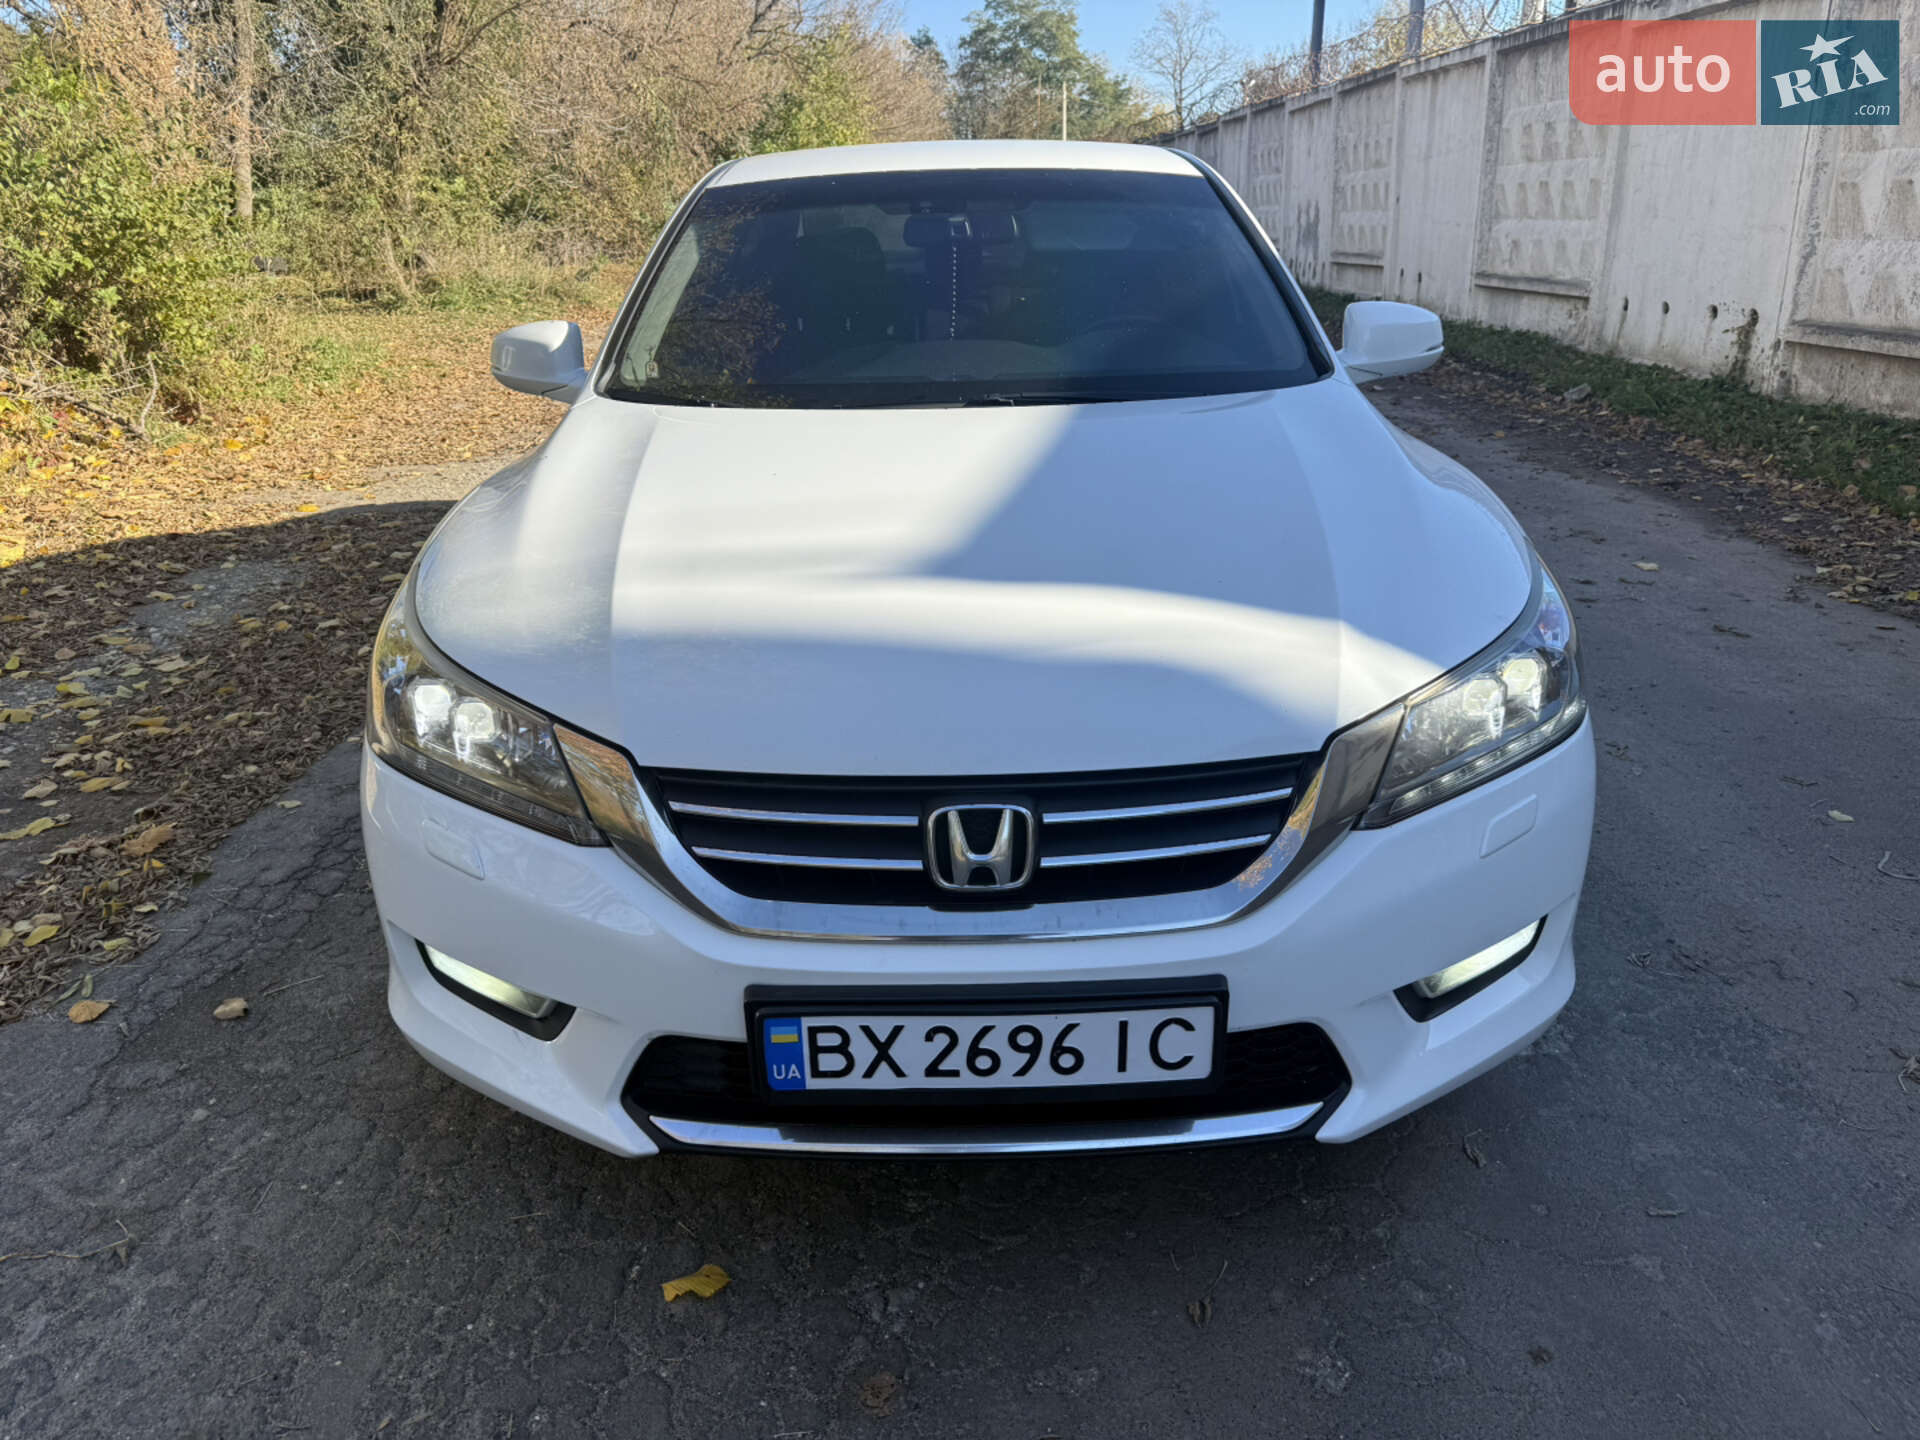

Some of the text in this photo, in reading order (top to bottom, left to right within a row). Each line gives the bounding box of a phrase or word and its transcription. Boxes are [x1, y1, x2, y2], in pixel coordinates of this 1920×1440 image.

[807, 1017, 1196, 1079] BX 2696 IC
[773, 1064, 801, 1080] UA
